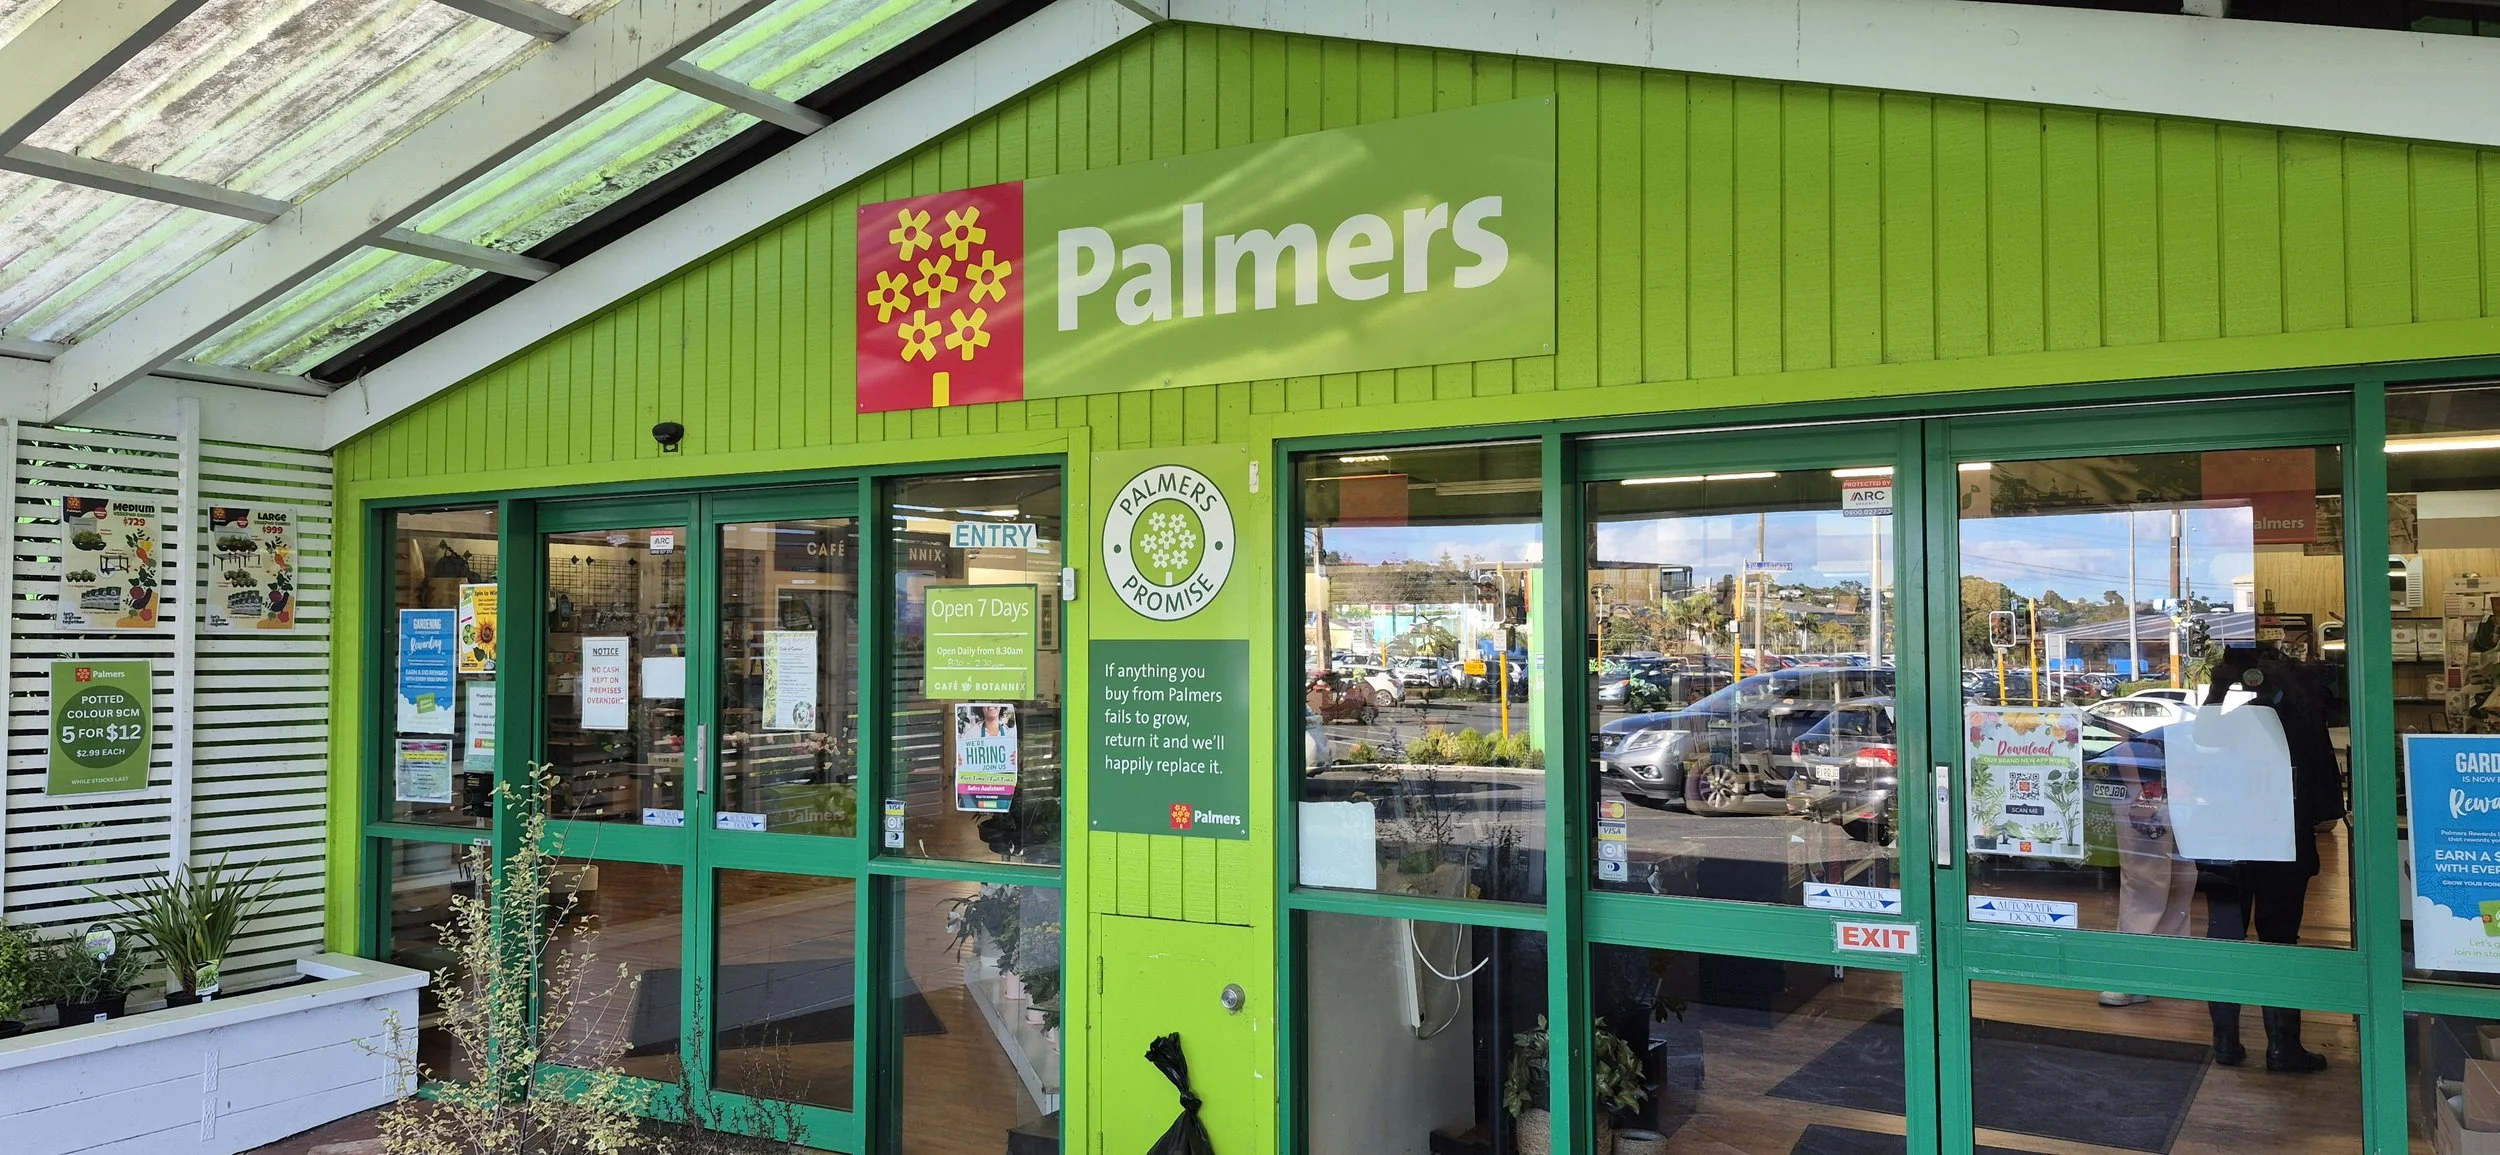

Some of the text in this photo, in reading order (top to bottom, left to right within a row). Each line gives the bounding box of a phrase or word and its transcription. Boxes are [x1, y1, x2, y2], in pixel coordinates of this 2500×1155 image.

[1058, 195, 1509, 332] Palmers
[1119, 472, 1218, 516] PALMERS
[1850, 490, 1884, 501] ARC
[113, 502, 155, 513] MEDIUM
[123, 517, 146, 526] $729
[258, 513, 286, 521] LARGE
[2254, 516, 2305, 530] almers
[956, 524, 1032, 547] ENTRY
[806, 540, 943, 562] CAFÉ NNIX
[1122, 573, 1214, 613] PROMISE
[932, 598, 1029, 623] Open 7 Days
[937, 647, 955, 657] Open
[957, 647, 975, 657] Daily
[977, 647, 994, 655] from
[1105, 663, 1205, 682] If anything you
[934, 680, 1026, 691] CAFÉ BOTANNIX
[81, 695, 124, 704] POTTED
[1105, 686, 1222, 704] buy from Palmers
[67, 708, 140, 719] COLOUR 9CM
[1105, 709, 1190, 729] fails to grow,
[62, 723, 141, 744] 5 FOR $12
[1105, 733, 1224, 750] return it and we'll
[1997, 740, 2055, 757] Download
[966, 746, 1006, 765] HIRING
[2456, 752, 2500, 773] GARD
[1105, 755, 1223, 776] happily replace it.
[2450, 788, 2500, 819] Rewa
[788, 809, 846, 822] Palmers
[1194, 810, 1240, 825] Palmers
[2435, 850, 2476, 861] EARN
[2480, 852, 2490, 861] A
[2435, 864, 2500, 874] WITH EVER
[1833, 889, 1887, 899] AUTOMATIC
[1844, 900, 1879, 909] DOOR
[1998, 901, 2056, 913] AUTOMATIC
[2009, 913, 2047, 923] DOOR
[1843, 927, 1910, 949] EXIT
[2470, 939, 2491, 947] Let's
